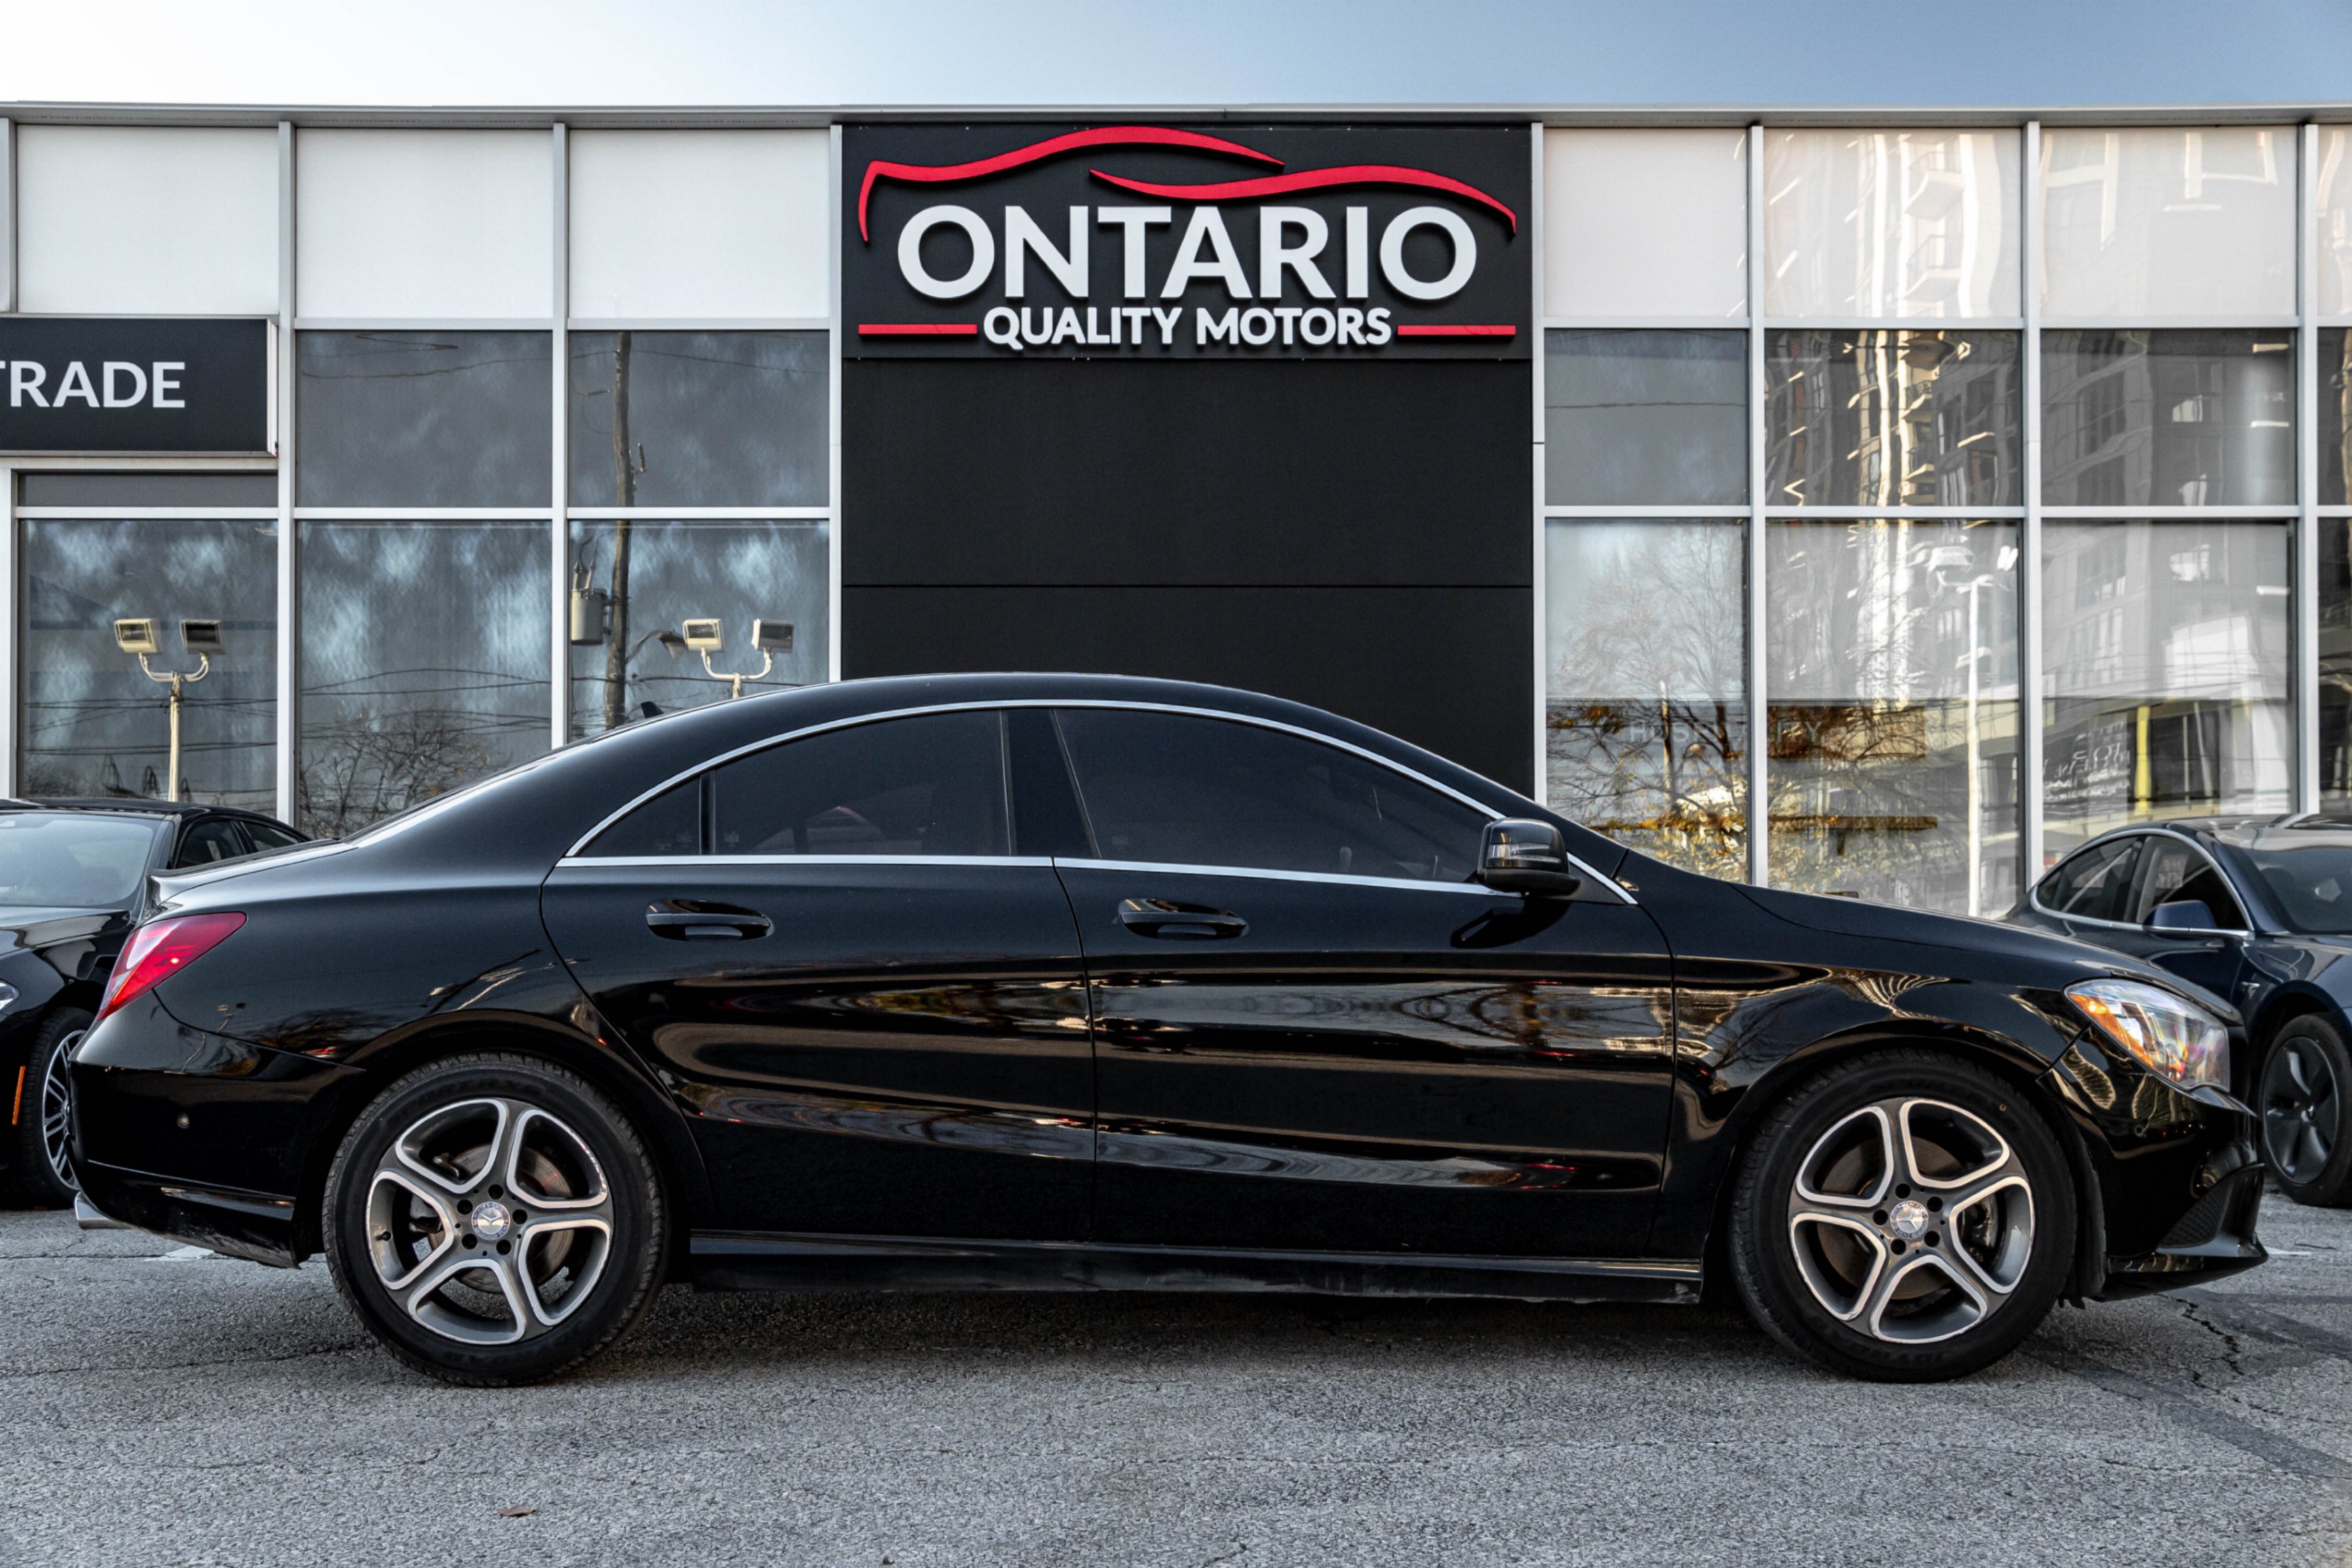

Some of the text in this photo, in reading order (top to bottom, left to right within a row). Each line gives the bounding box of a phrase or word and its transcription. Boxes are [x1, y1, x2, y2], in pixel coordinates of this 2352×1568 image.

[898, 205, 1476, 299] ONTARIO
[984, 307, 1391, 349] QUALITY MOTORS
[0, 361, 185, 408] RADE
